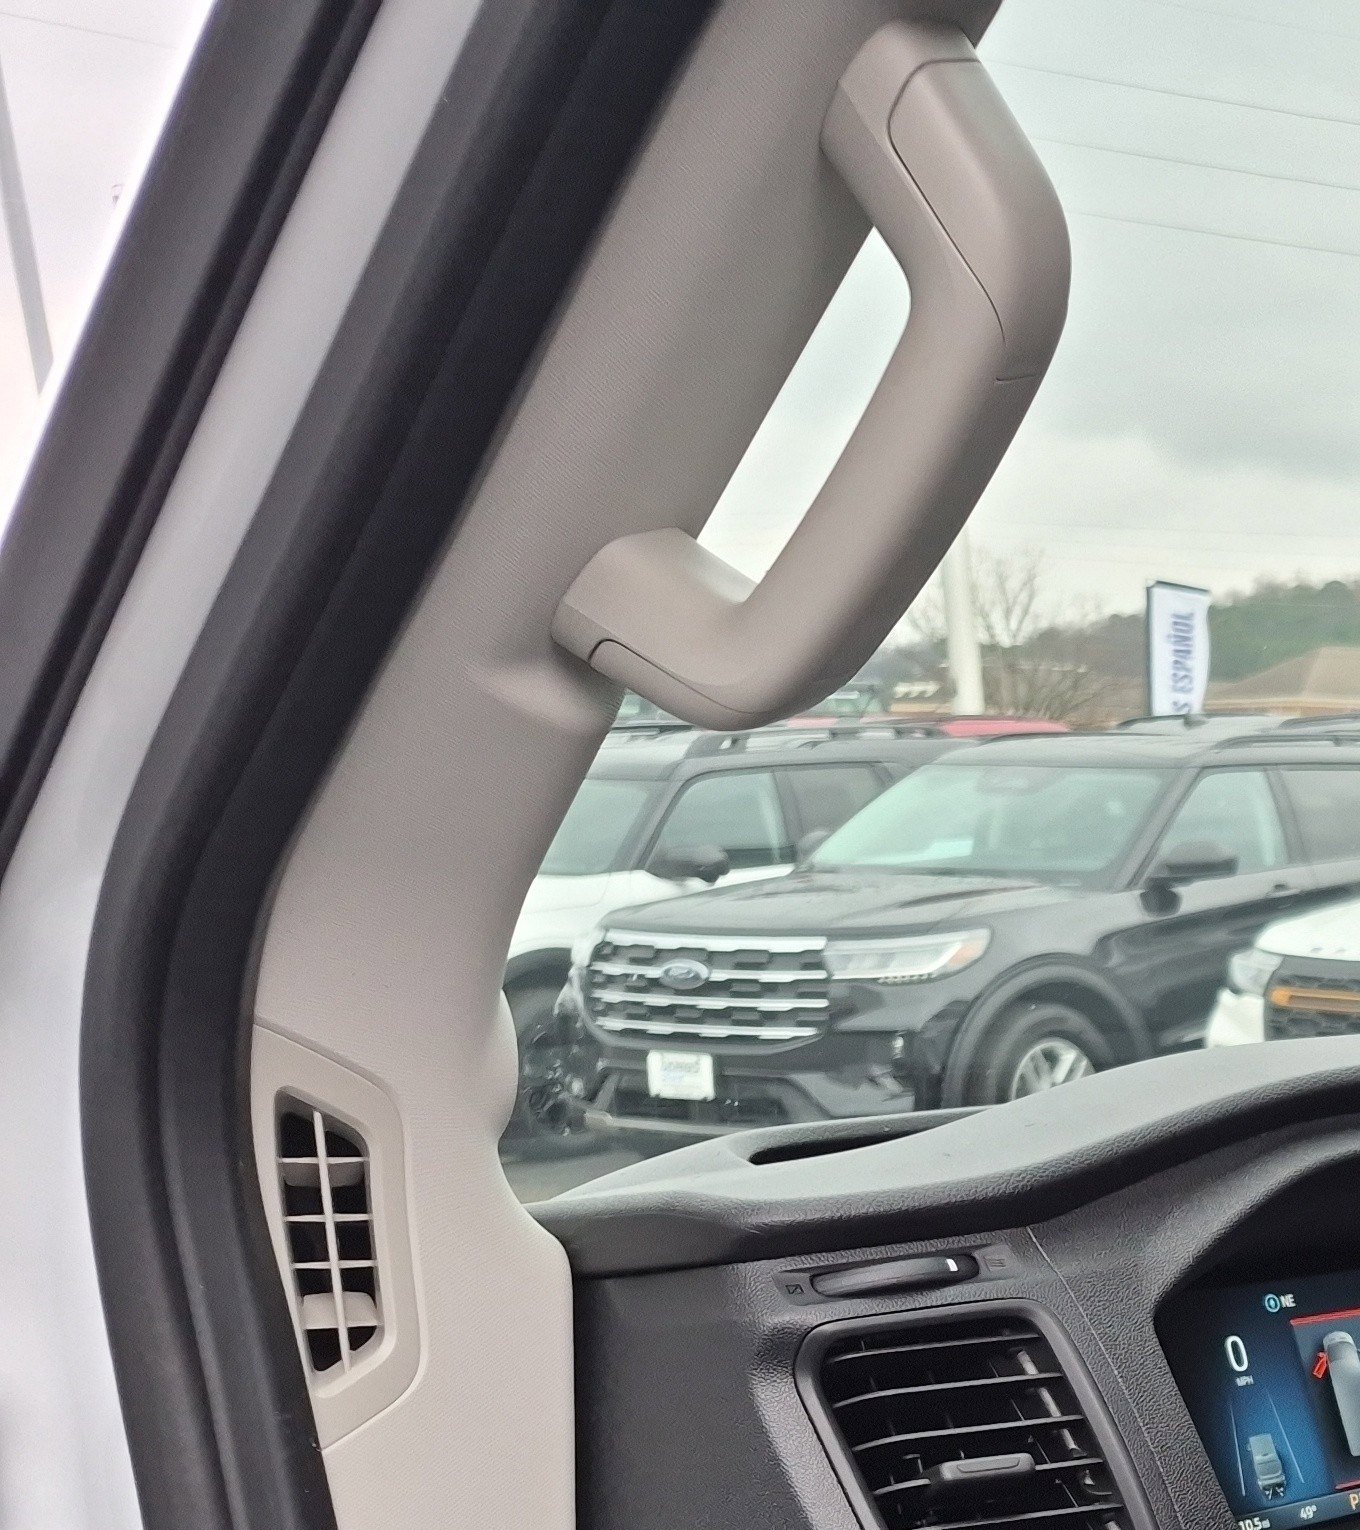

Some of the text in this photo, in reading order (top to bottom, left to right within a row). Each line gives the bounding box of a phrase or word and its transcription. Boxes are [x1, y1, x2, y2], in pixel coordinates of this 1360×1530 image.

[1167, 612, 1194, 694] ESPAÑOL
[1280, 1293, 1297, 1308] NE
[1224, 1335, 1249, 1372] 0
